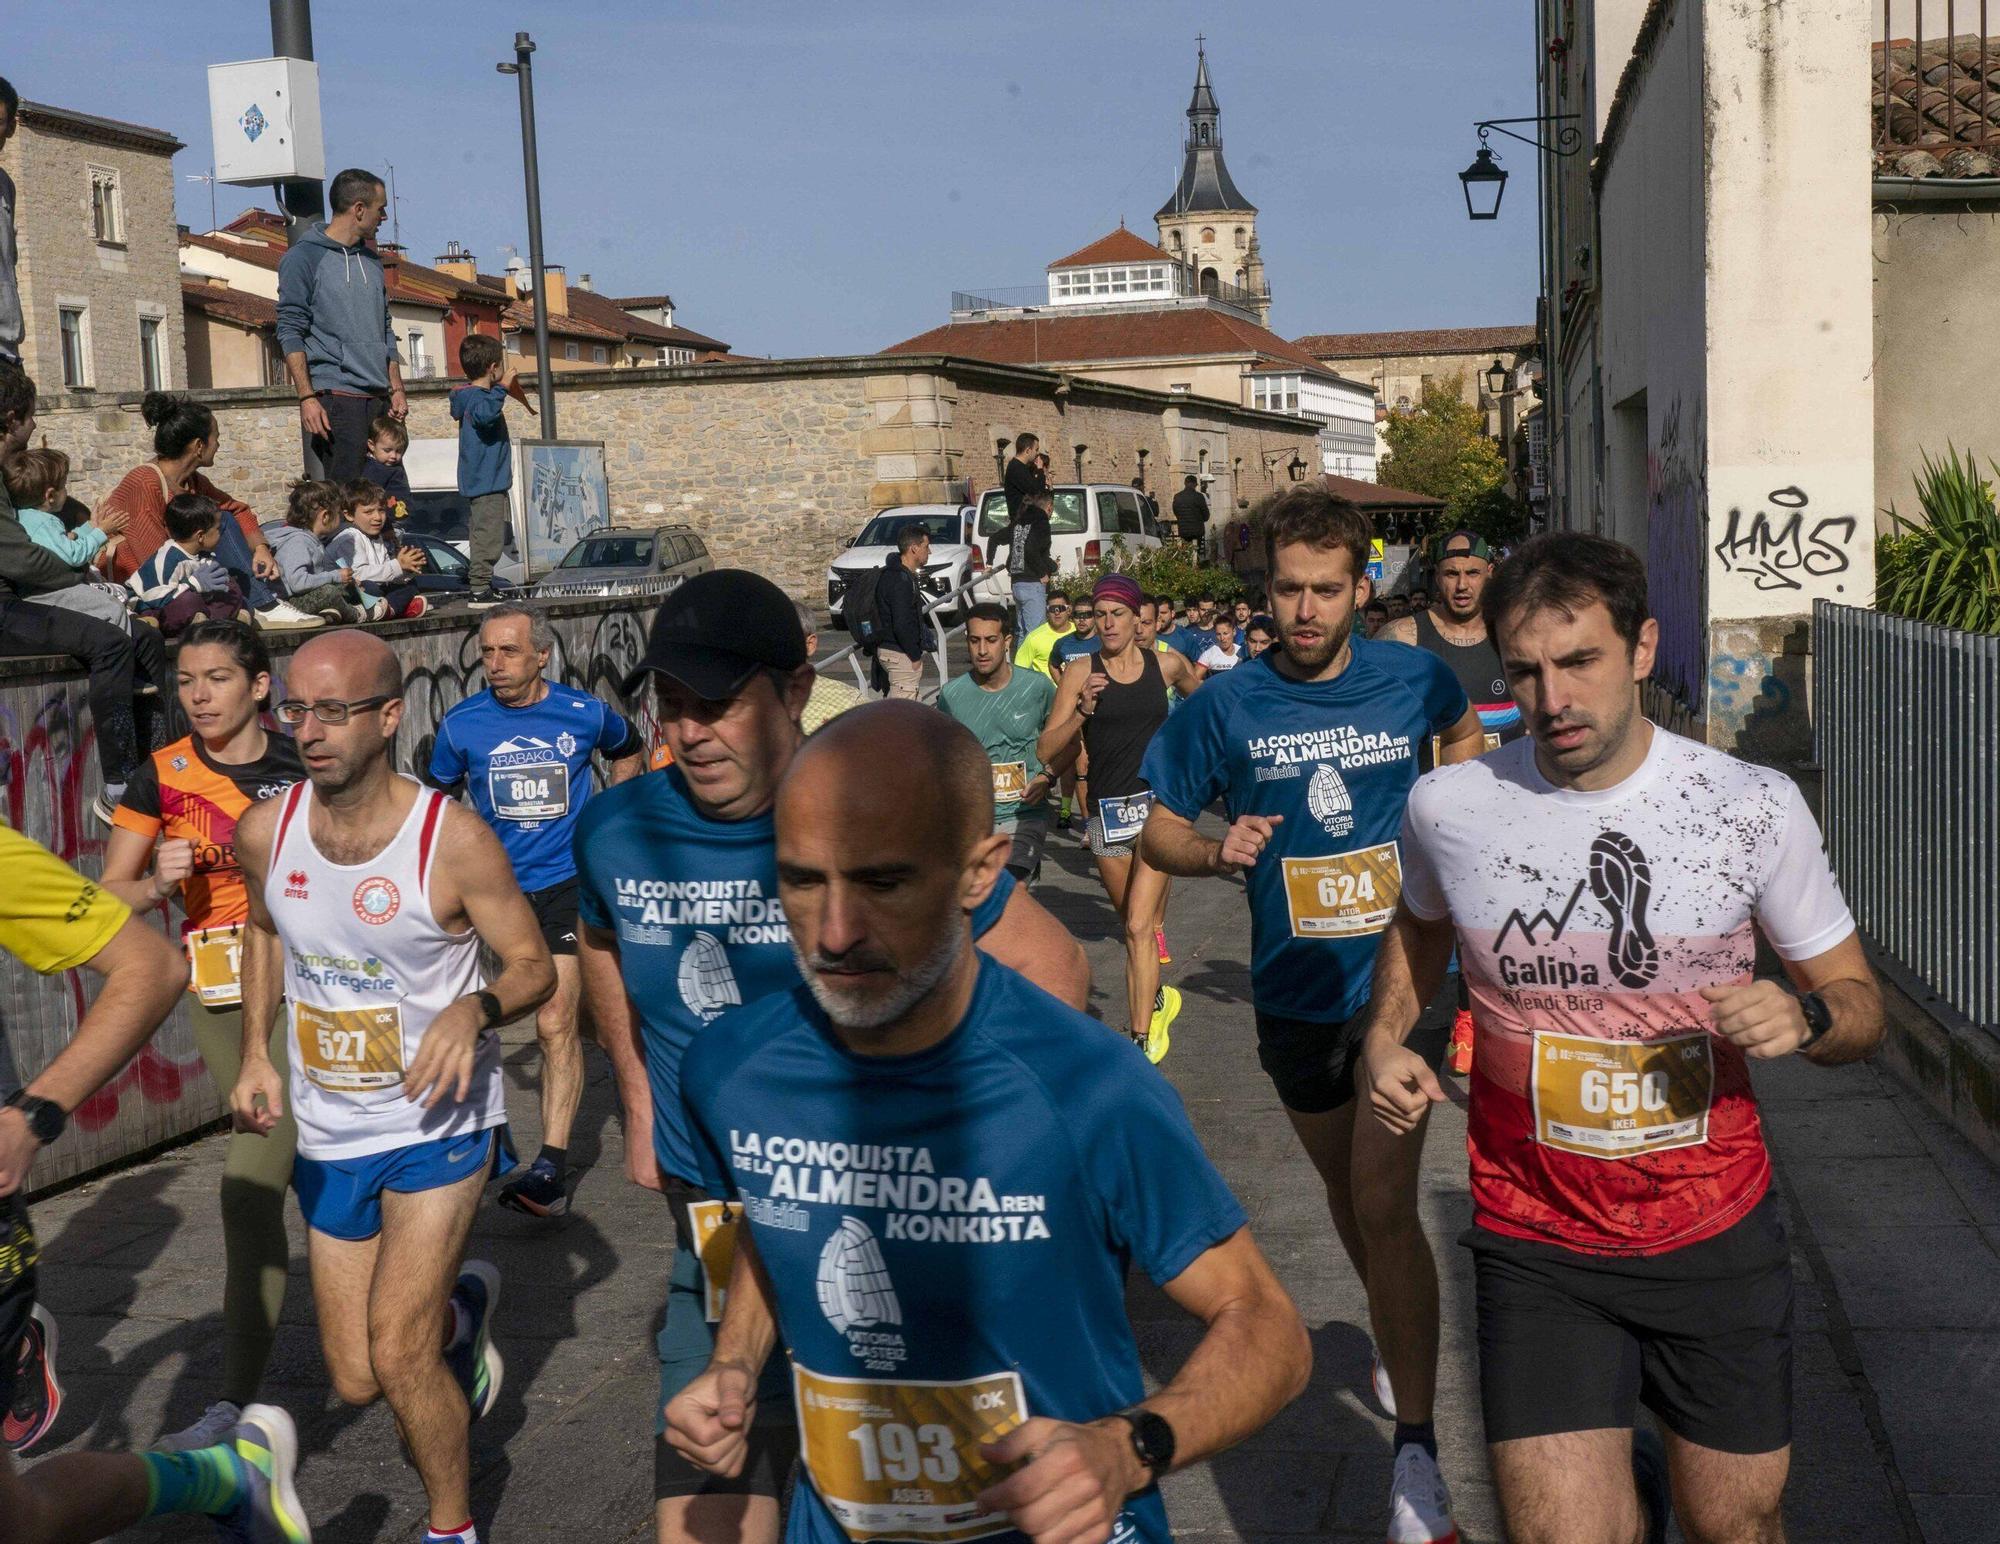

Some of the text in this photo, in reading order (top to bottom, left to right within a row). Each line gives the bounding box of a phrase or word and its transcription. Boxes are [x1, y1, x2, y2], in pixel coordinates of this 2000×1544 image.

[1248, 725, 1358, 751] LA CONQUISTA
[1250, 732, 1409, 765] DE LA ALMENDRA REN
[490, 749, 554, 767] ARABAKO
[1340, 747, 1411, 769] KONKISTA
[1263, 764, 1301, 781] Edición
[511, 779, 549, 800] 804
[1117, 803, 1149, 823] 993
[1323, 814, 1353, 825] VITORIA
[1324, 821, 1354, 832] GASTEIZ
[1377, 851, 1392, 862] 10K
[284, 888, 309, 900] errea
[614, 878, 763, 902] LA CONQUISTA
[1318, 870, 1376, 907] 624
[1338, 907, 1360, 917] AITOR
[324, 970, 395, 993] Fregene
[1498, 954, 1599, 989] Galipa
[1499, 990, 1604, 1011] Mendi Bira
[375, 1013, 393, 1024] 10K
[317, 1029, 366, 1062] 527
[1681, 1045, 1701, 1059] 10K
[1580, 1070, 1669, 1114] 650
[1612, 1118, 1637, 1130] IKER
[730, 1129, 935, 1174] LA CONQUISTA
[732, 1154, 1046, 1212] DE LA ALMENDRA REN
[884, 1213, 1051, 1242] KONKISTA
[846, 1330, 906, 1347] VITORIA
[972, 1390, 1006, 1411] 10K
[847, 1422, 961, 1483] 193
